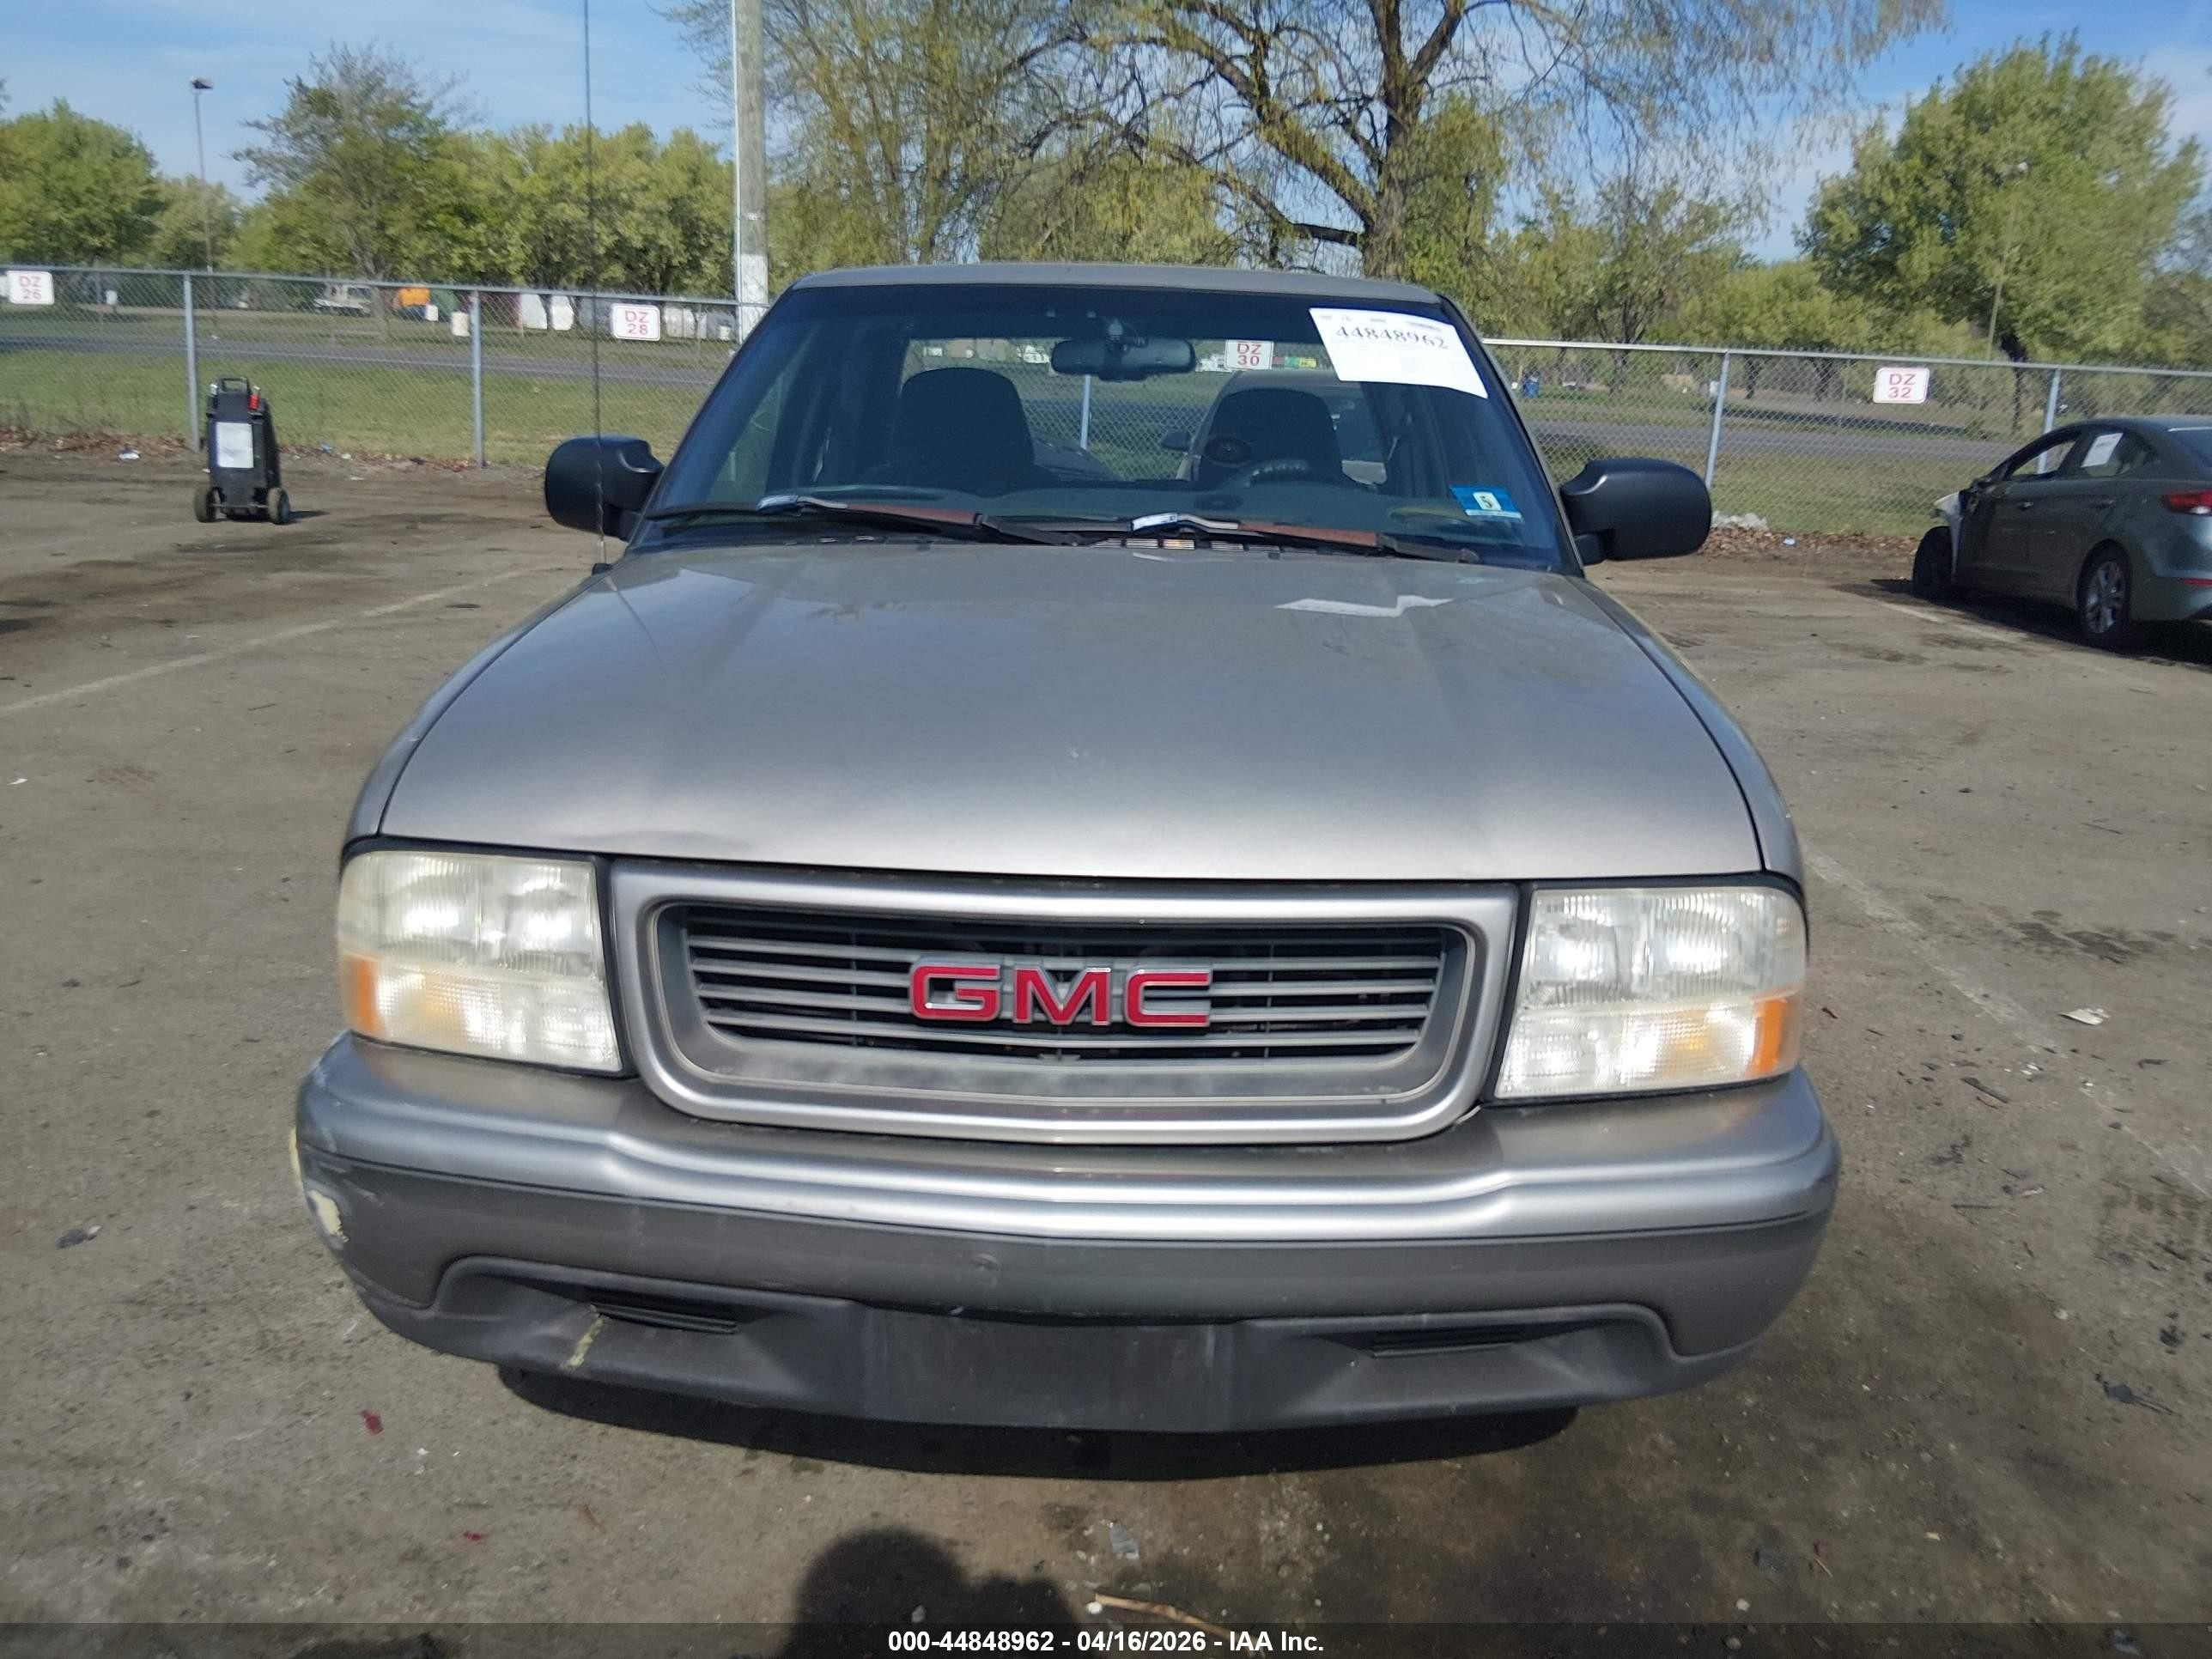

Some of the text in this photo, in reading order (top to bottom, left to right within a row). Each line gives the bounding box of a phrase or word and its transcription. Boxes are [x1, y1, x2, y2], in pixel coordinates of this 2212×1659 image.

[19, 276, 42, 288] DZ
[624, 310, 648, 323] DZ
[627, 323, 648, 335] 28
[1335, 325, 1449, 350] 44848962
[1237, 343, 1262, 355] DZ
[1237, 354, 1261, 367] 30
[1889, 373, 1917, 386] DZ
[1887, 386, 1911, 399] 32
[909, 961, 1212, 1027] GMC
